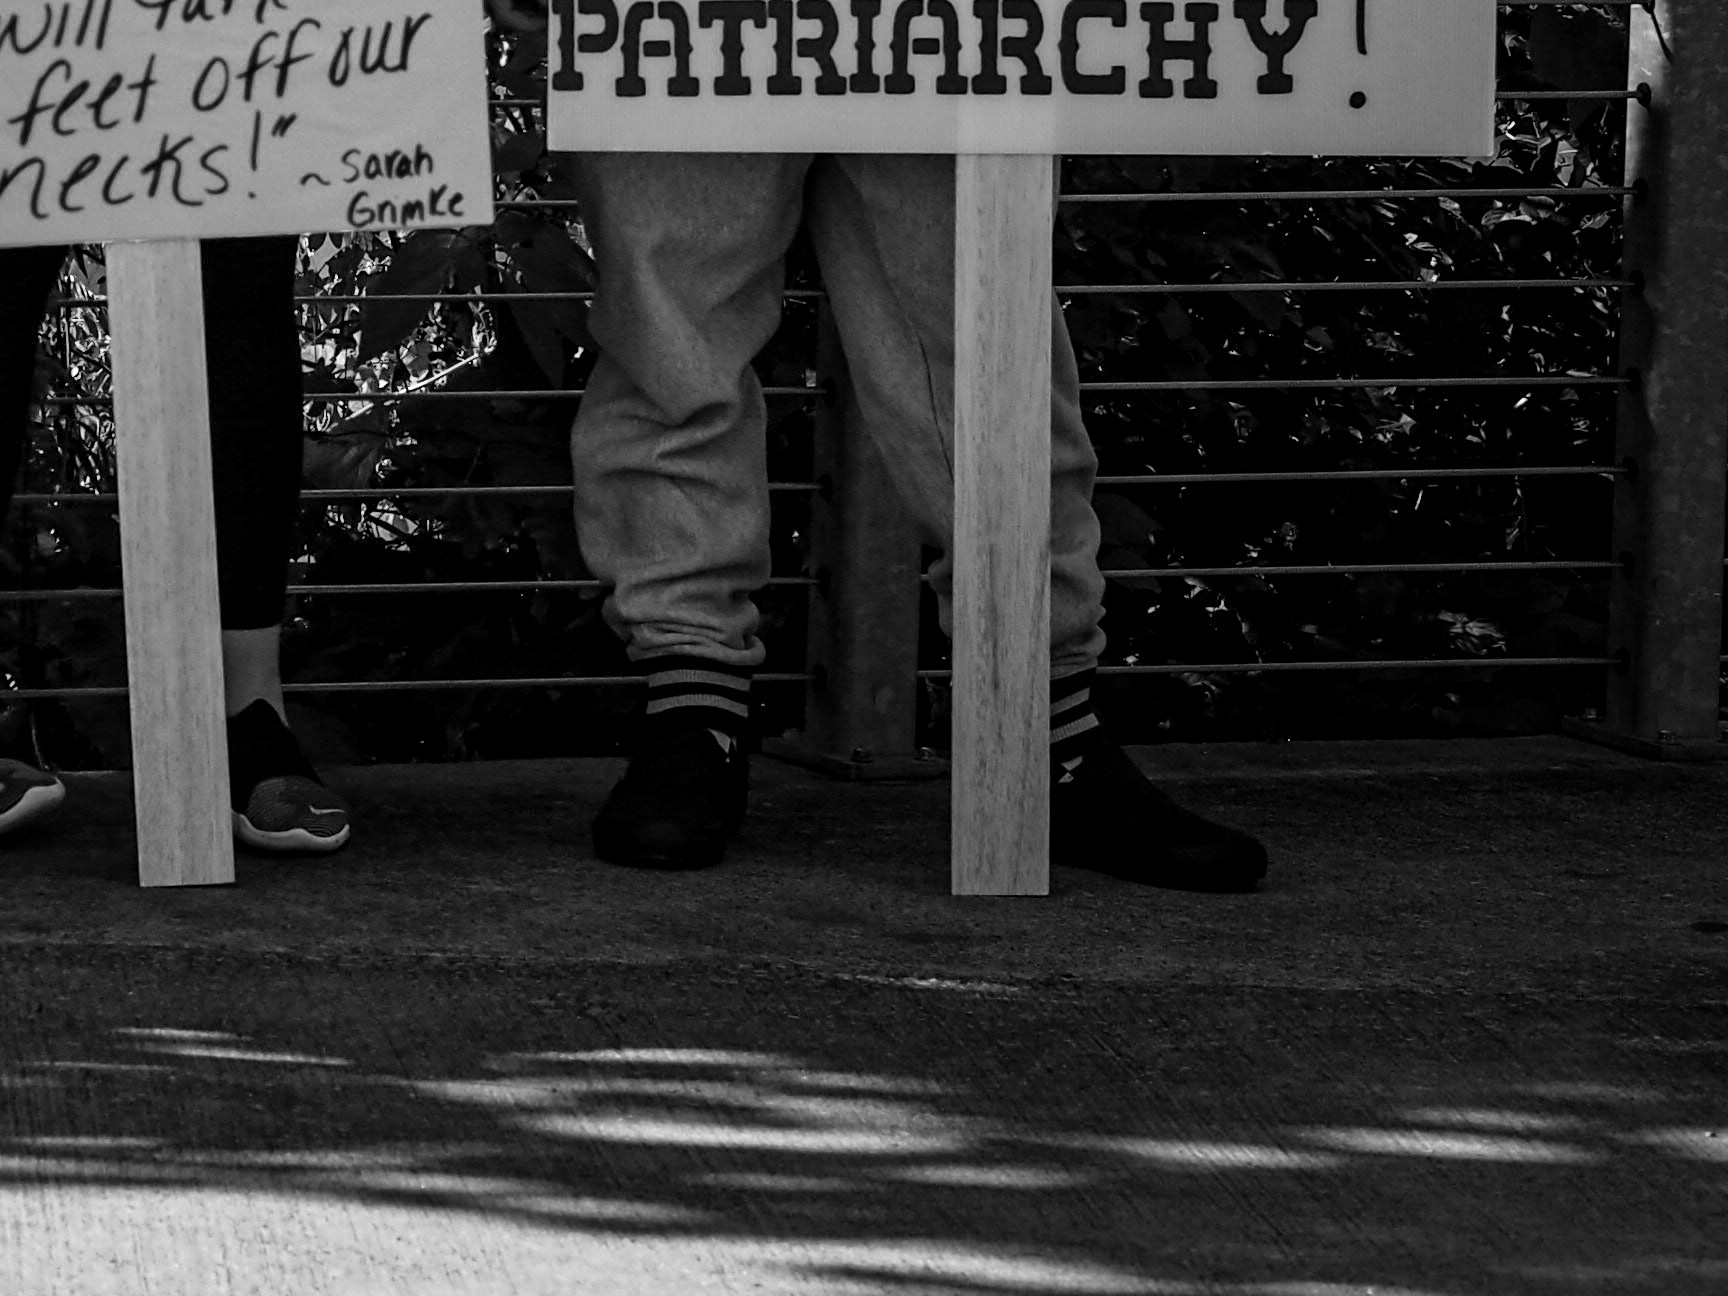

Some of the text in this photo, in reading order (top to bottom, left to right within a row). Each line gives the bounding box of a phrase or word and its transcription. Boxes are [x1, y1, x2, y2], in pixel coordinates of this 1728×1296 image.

[7, 54, 158, 148] feet
[191, 19, 321, 113] off
[329, 14, 432, 87] our
